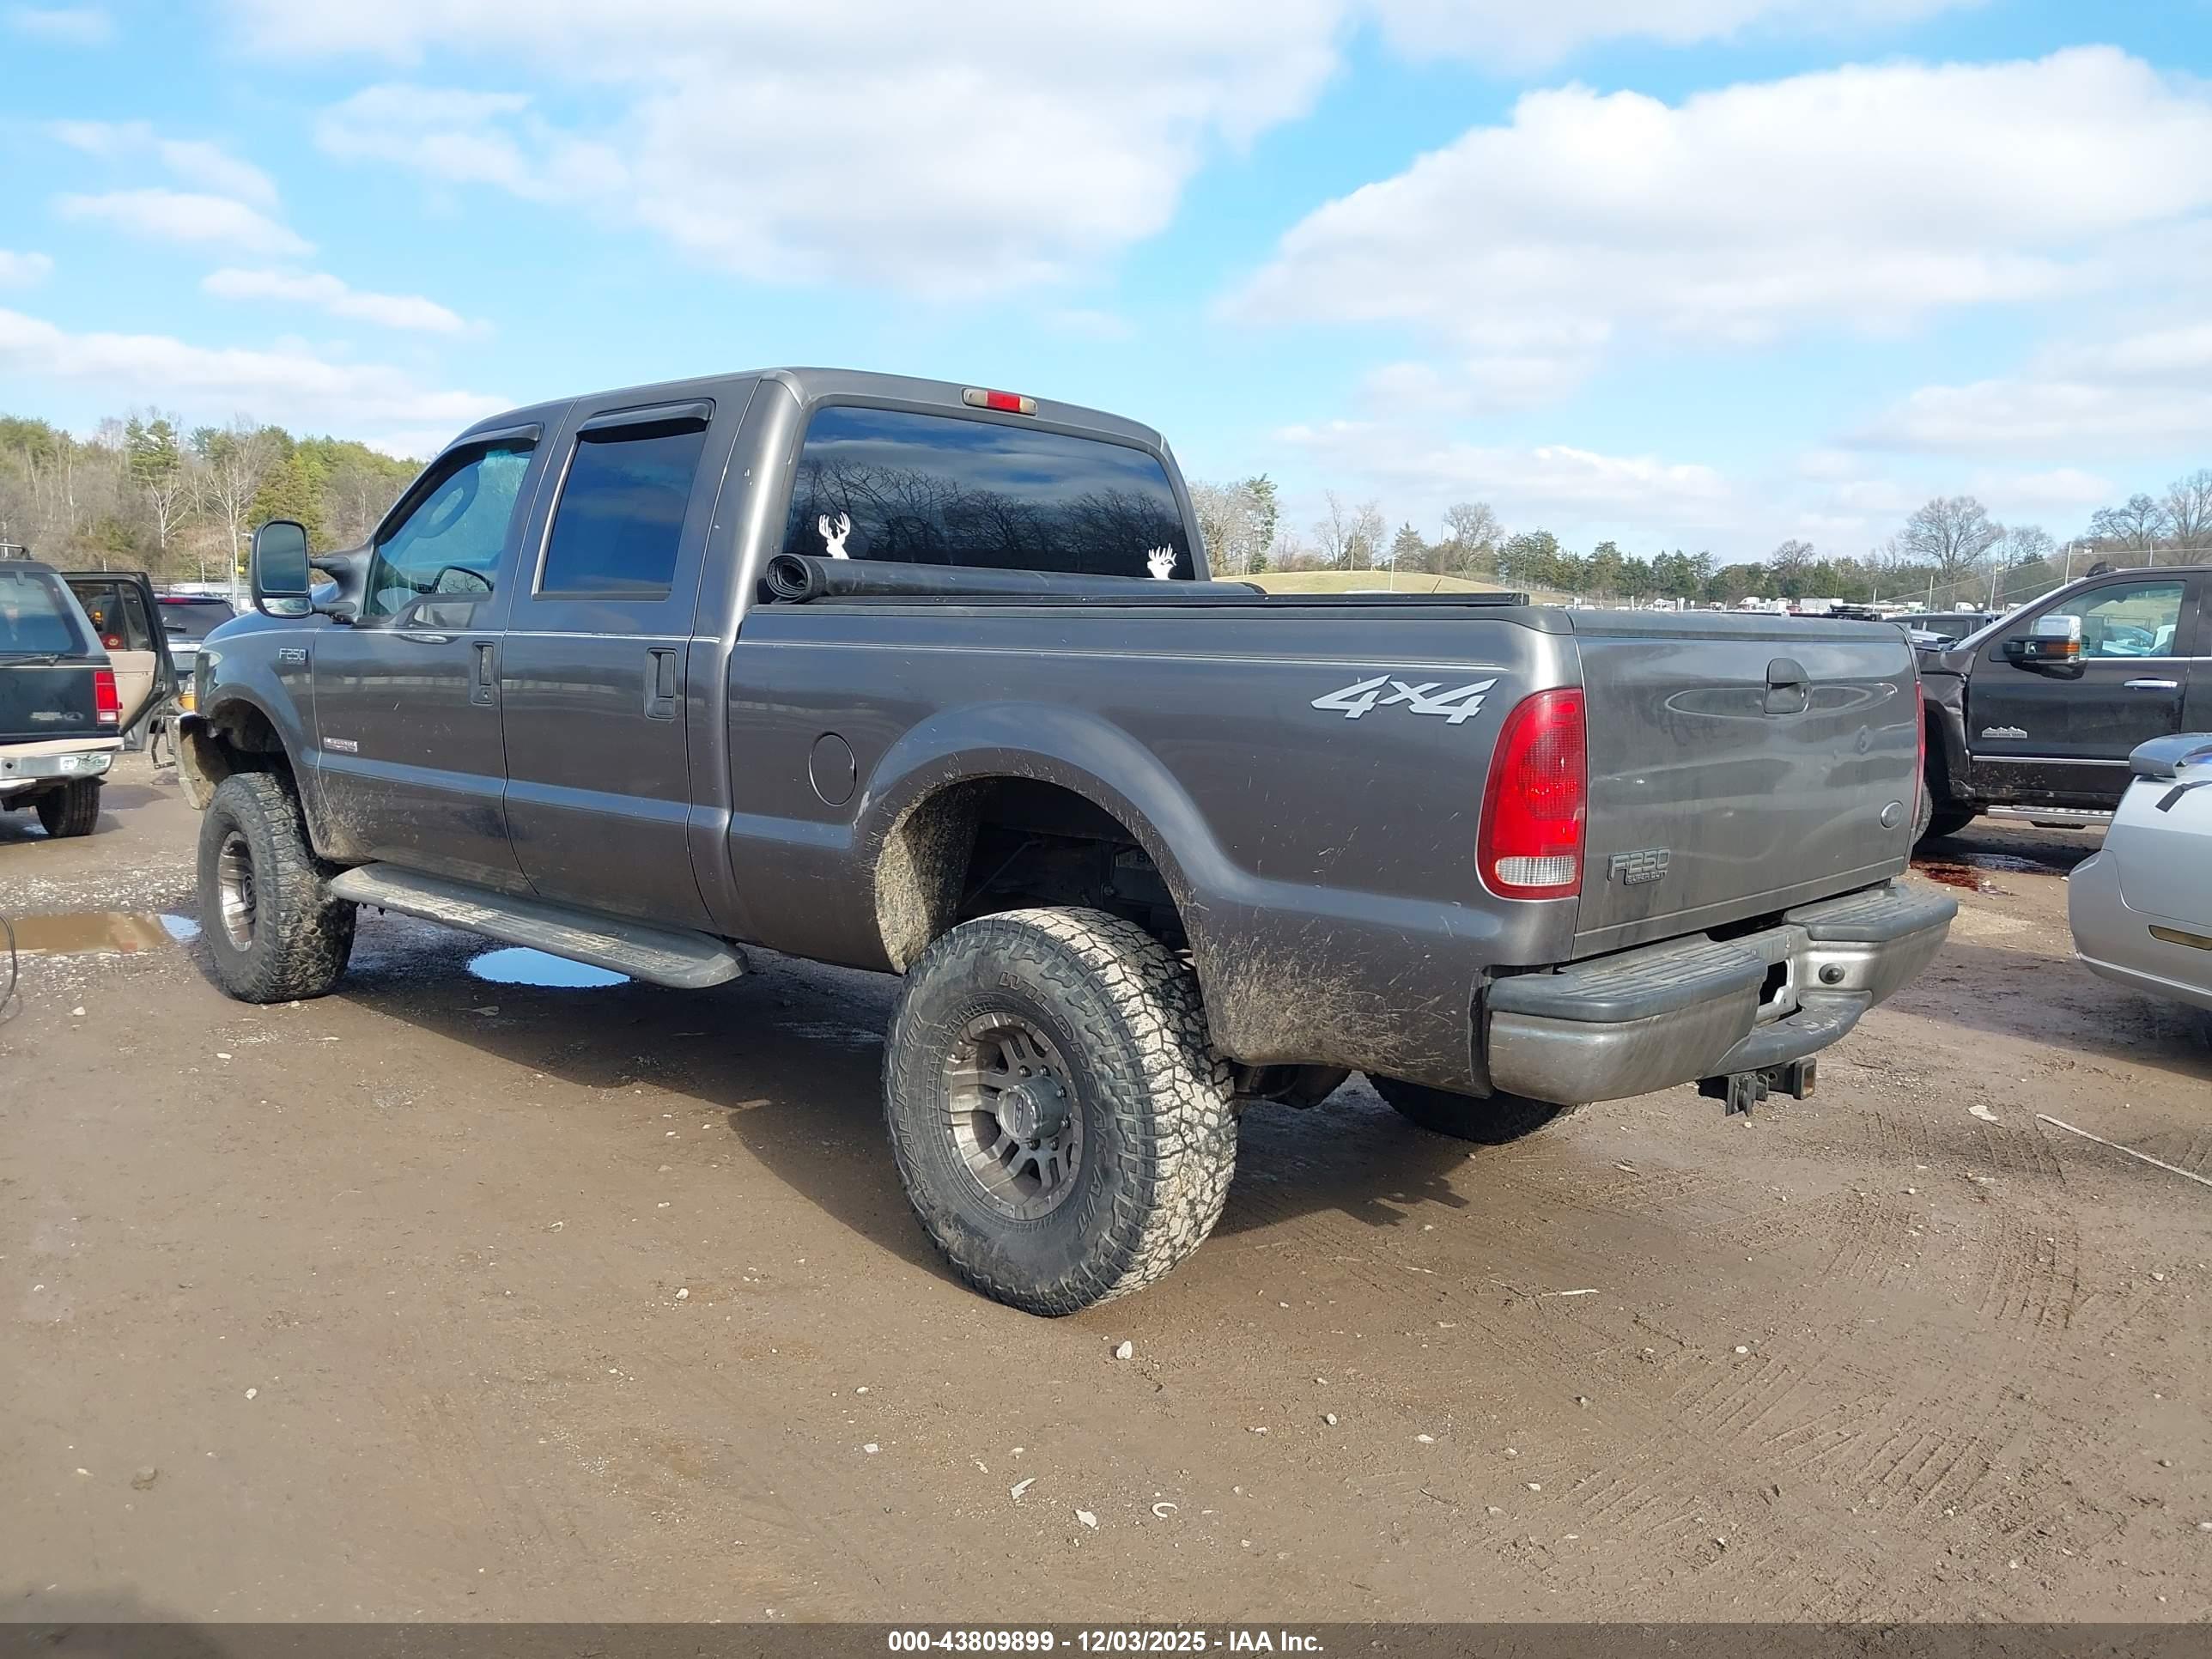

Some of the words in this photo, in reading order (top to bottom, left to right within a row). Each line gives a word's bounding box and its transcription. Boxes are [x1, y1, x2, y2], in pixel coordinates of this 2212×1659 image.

[278, 647, 306, 660] F250
[1310, 673, 1498, 725] 4x4
[1610, 848, 1670, 879] F250
[1627, 872, 1650, 884] SUPER
[998, 971, 1108, 1164] WILDPEAK
